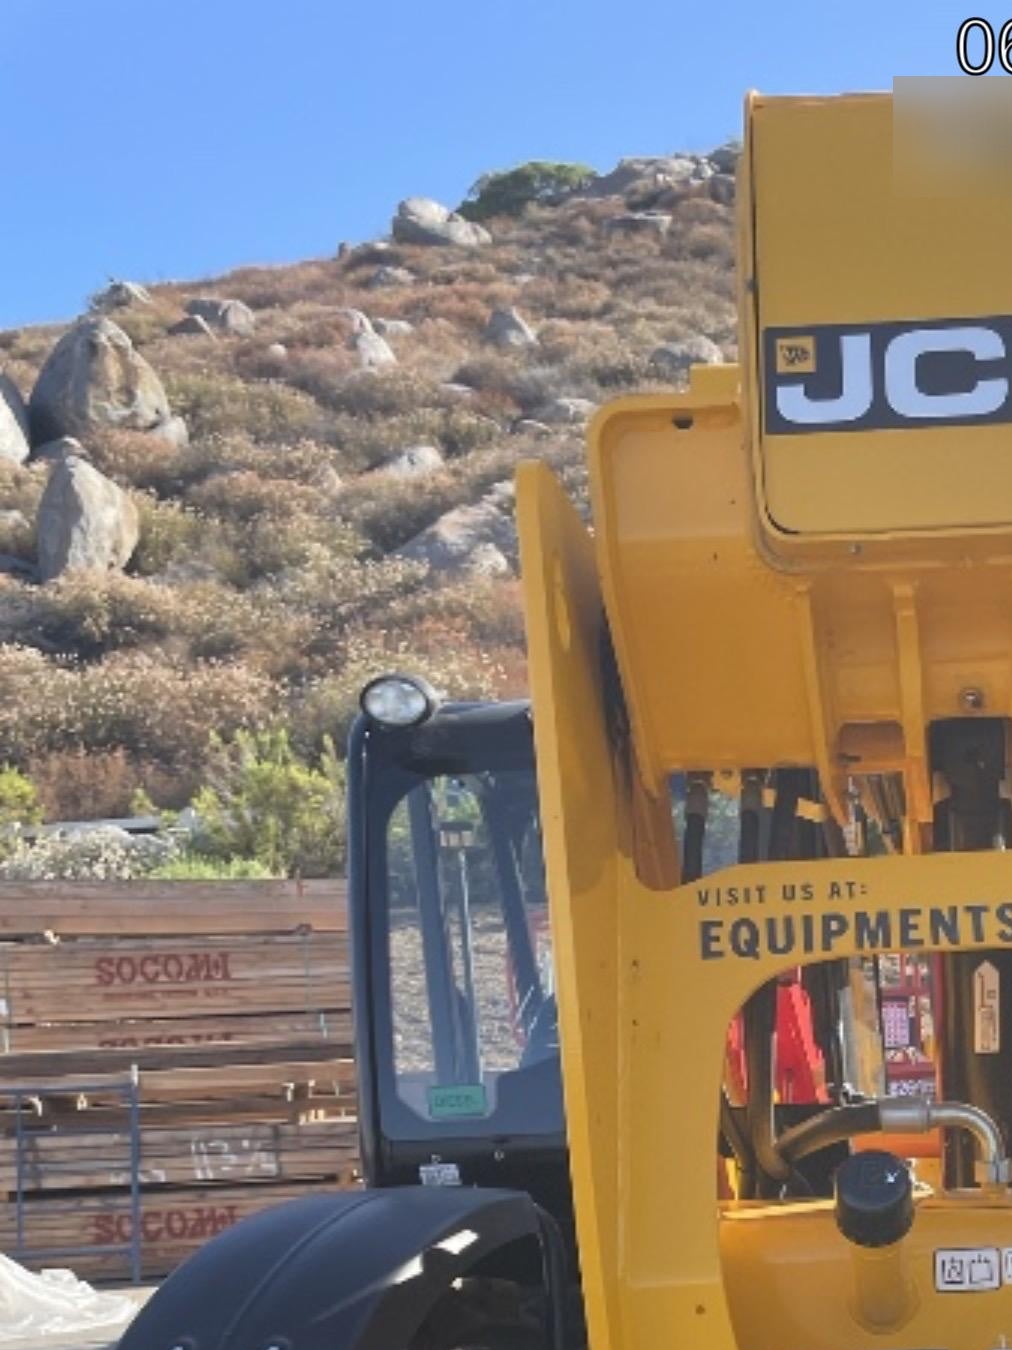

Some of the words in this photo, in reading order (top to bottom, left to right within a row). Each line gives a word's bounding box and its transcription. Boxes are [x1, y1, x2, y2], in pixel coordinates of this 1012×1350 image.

[698, 885, 766, 907] VISIT
[782, 884, 814, 901] US
[829, 881, 868, 899] AT:
